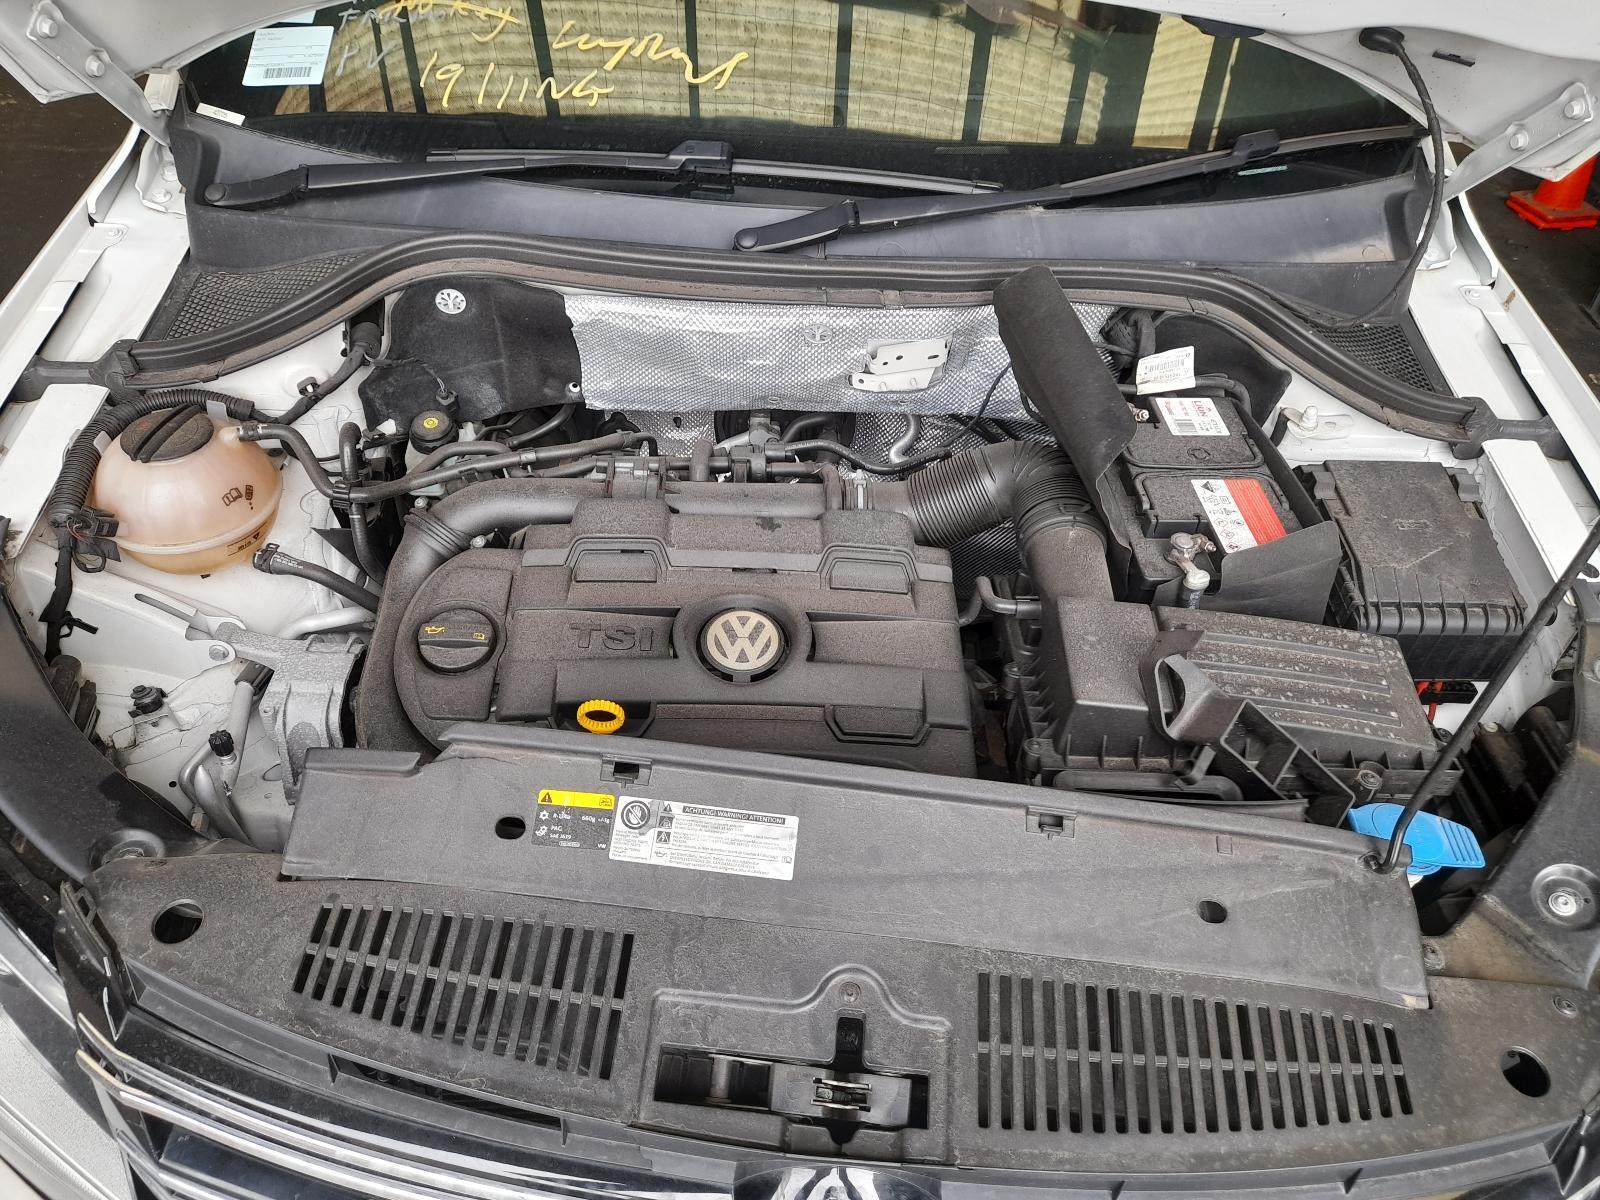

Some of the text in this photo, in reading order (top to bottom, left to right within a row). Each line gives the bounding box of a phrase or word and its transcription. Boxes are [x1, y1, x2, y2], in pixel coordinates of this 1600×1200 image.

[569, 622, 654, 652] TSI
[717, 810, 749, 820] WARNING!
[749, 814, 784, 824] ATTENTION!
